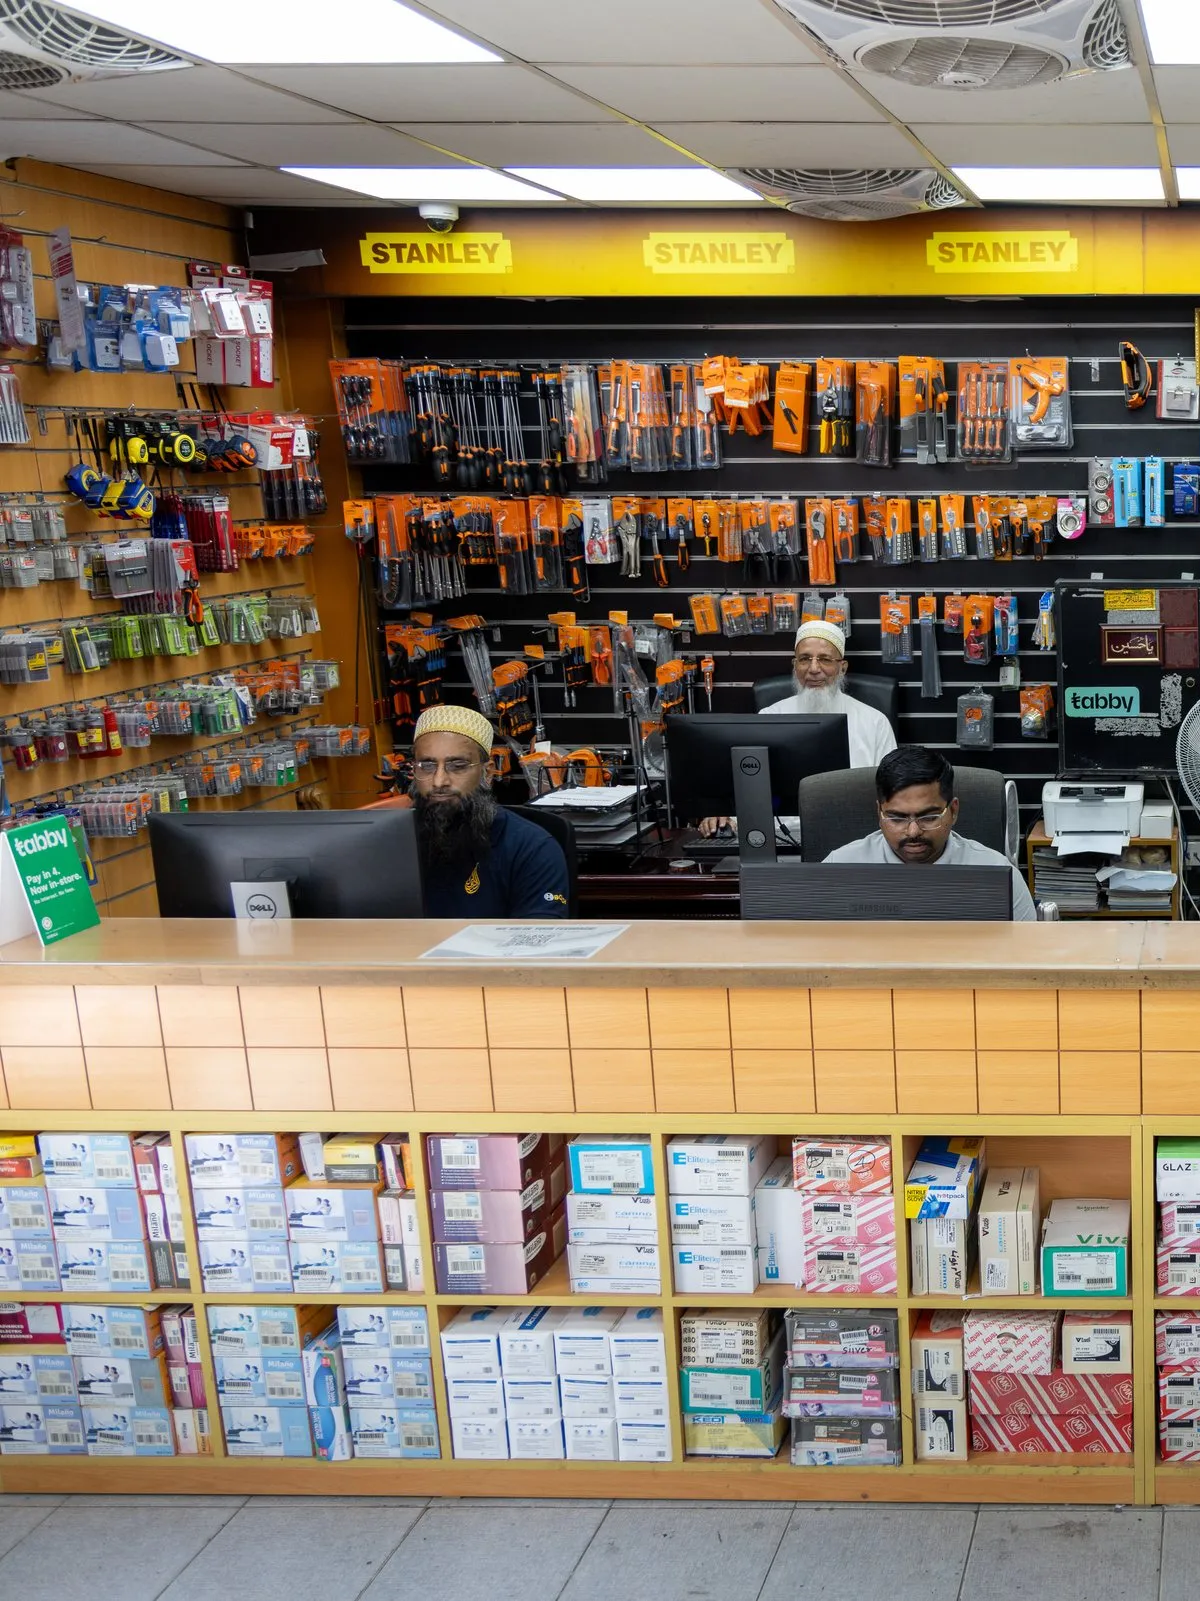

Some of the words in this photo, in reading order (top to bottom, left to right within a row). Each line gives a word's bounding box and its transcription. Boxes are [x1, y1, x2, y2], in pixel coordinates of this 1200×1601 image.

[372, 242, 500, 264] STANLEY
[654, 242, 783, 264] STANLEY
[937, 240, 1067, 263] STANLEY
[1071, 692, 1134, 713] tabby
[742, 762, 759, 770] DELL
[14, 828, 68, 856] tabby
[26, 874, 41, 885] Pay
[42, 870, 51, 880] in
[52, 867, 60, 876] 4.
[30, 884, 48, 896] Now
[49, 873, 82, 889] in-store.
[249, 904, 273, 912] DELL
[242, 1137, 270, 1146] Milano
[12, 1190, 38, 1198] Milano
[248, 1191, 276, 1200] Milano
[936, 1192, 966, 1200] hotpack
[20, 1242, 47, 1250] Milano
[254, 1244, 280, 1252] Milano
[261, 1310, 288, 1318] Milano
[392, 1310, 419, 1318] Milano
[38, 1358, 65, 1368] Milano
[268, 1360, 294, 1368] Milano
[396, 1360, 423, 1368] Milano
[48, 1408, 74, 1416] Milano
[135, 1410, 160, 1418] Milano
